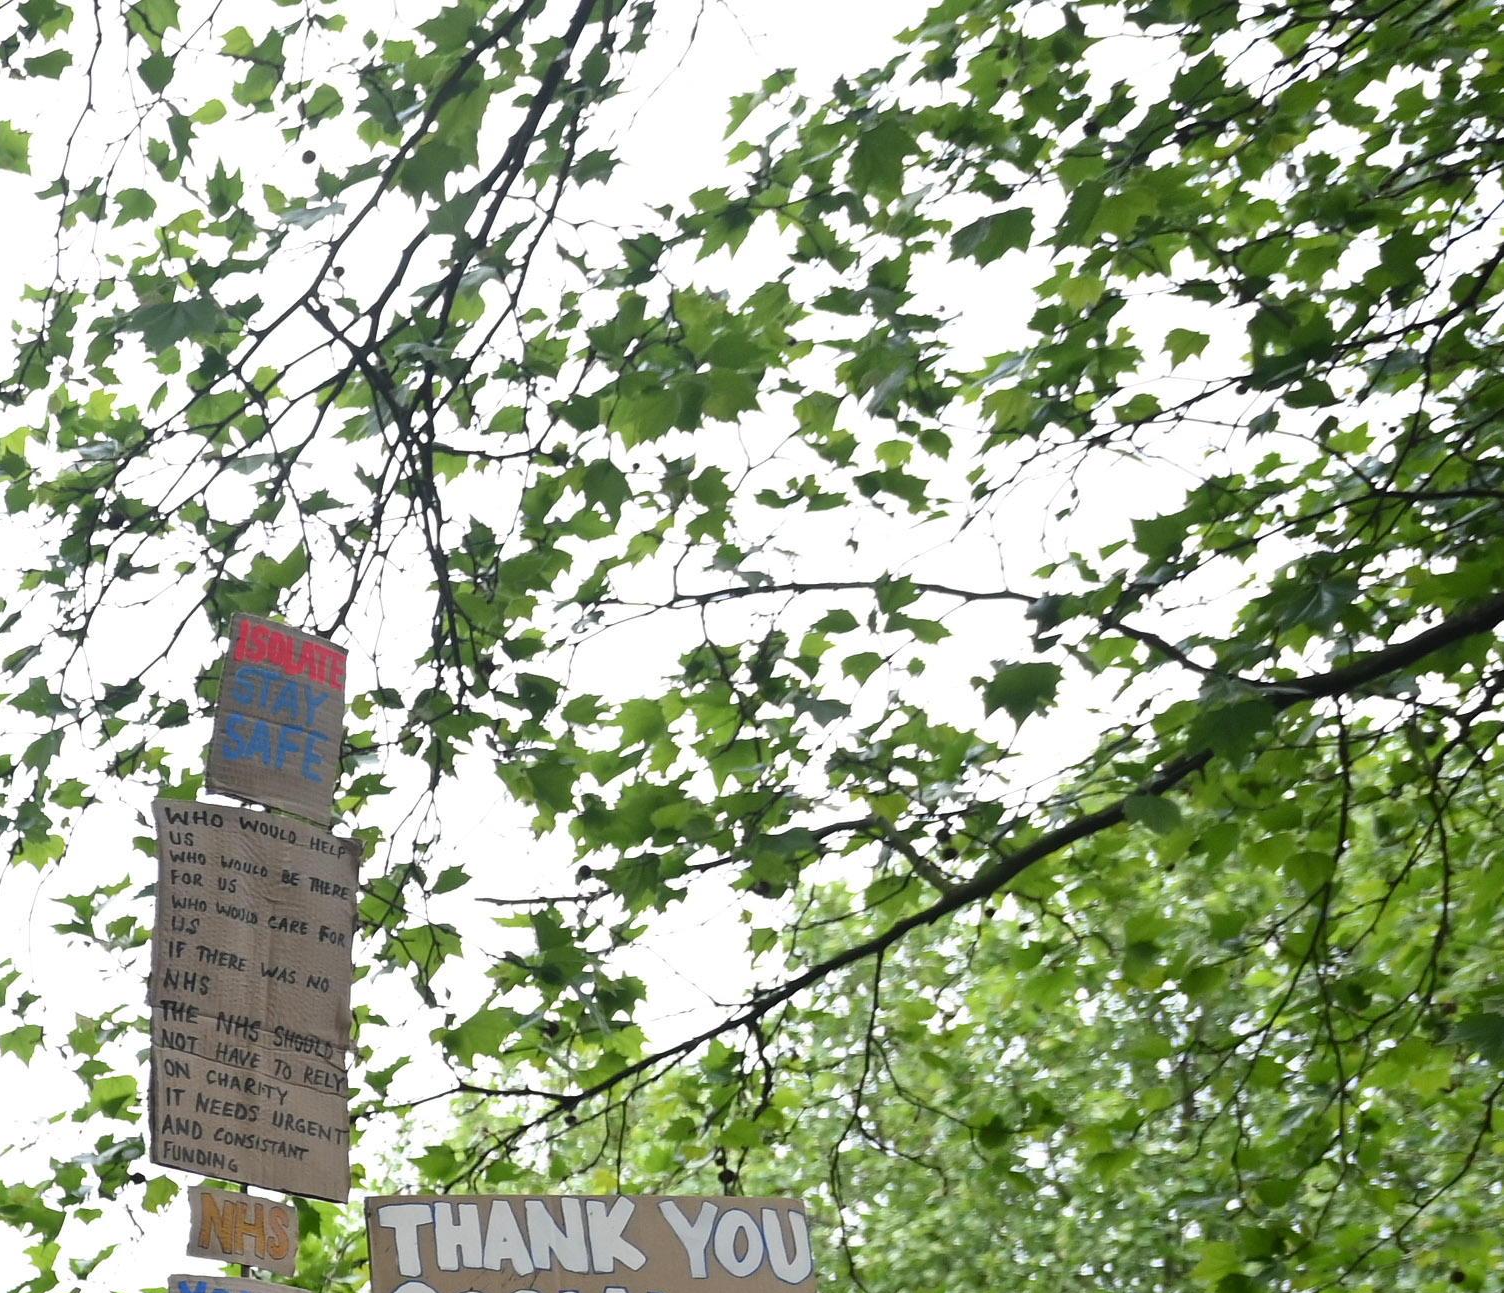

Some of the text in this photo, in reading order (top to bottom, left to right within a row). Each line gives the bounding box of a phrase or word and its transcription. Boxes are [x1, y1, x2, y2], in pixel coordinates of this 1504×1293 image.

[235, 620, 347, 691] ISOLATE
[232, 666, 331, 726] STAY
[222, 712, 328, 783] SAFE
[165, 807, 346, 859] WHO WOULD HELP
[169, 851, 350, 900] WHO WOULD THERE
[171, 869, 203, 886] FOR
[268, 916, 345, 947] CARE FOR
[163, 968, 210, 995] NHS
[196, 946, 296, 984] THERE WAS
[160, 1000, 261, 1042] THE NHS
[216, 1042, 346, 1092] HAVE RELY
[162, 1114, 202, 1140] AND
[196, 1092, 350, 1144] NEEDS URGENT
[163, 1141, 238, 1173] FUNDING
[198, 1193, 289, 1260] NHS
[379, 1195, 814, 1284] THANK YOU
